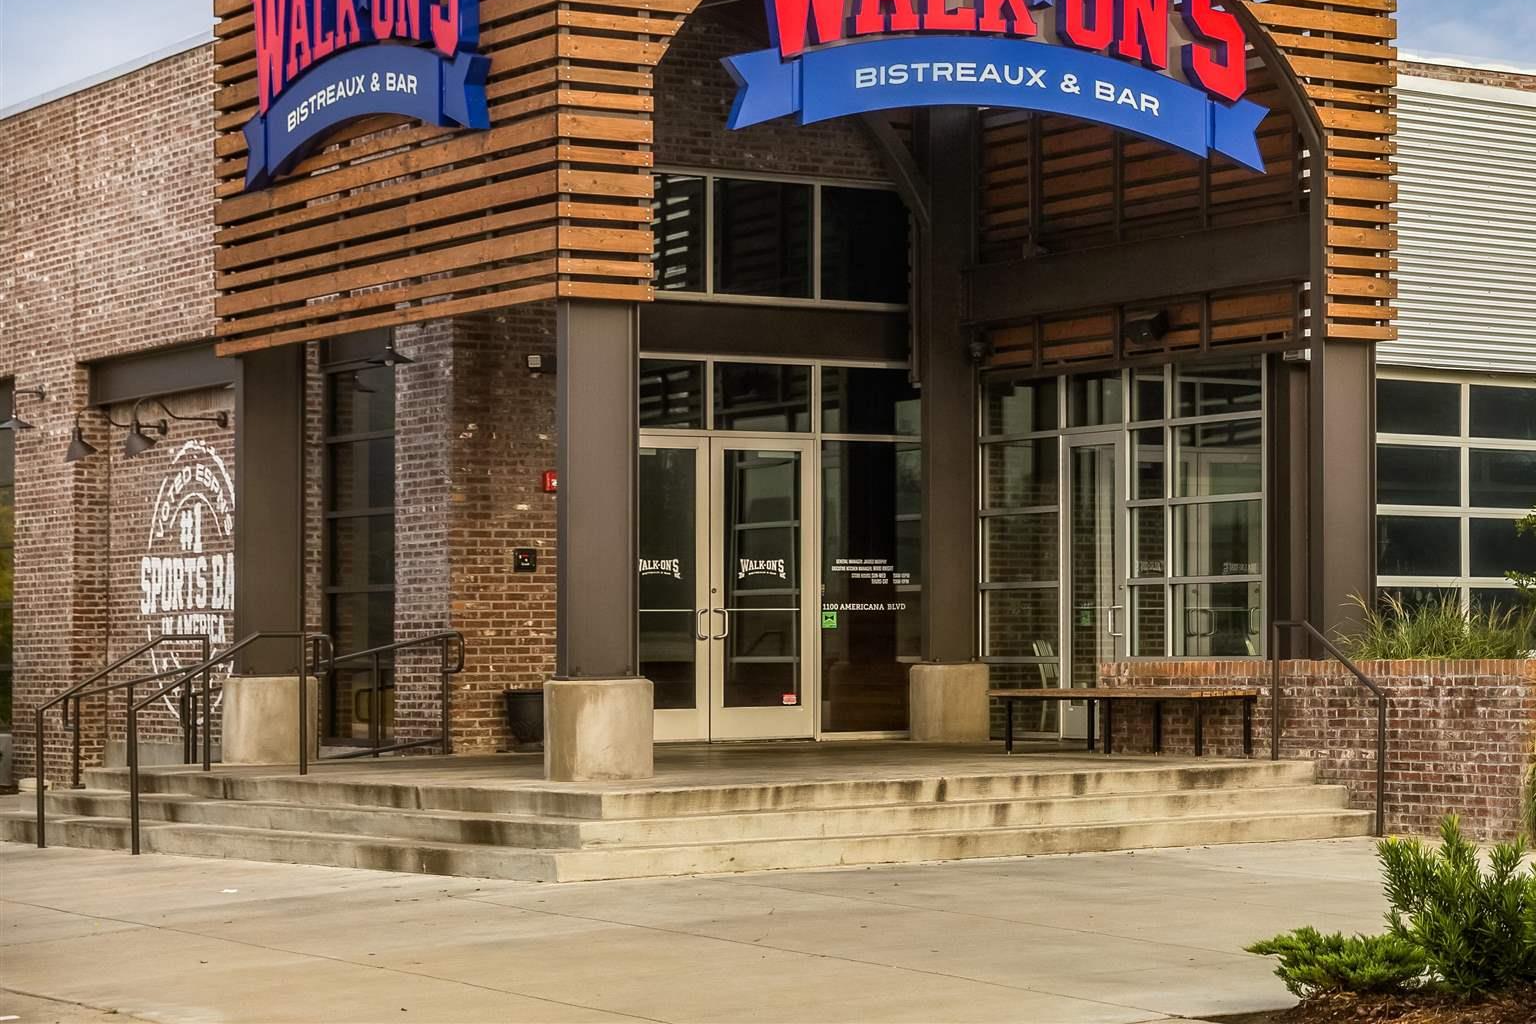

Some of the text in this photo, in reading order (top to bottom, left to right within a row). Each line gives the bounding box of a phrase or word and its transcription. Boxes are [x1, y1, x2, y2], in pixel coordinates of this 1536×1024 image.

[287, 72, 417, 133] BISTREAUX & BAR
[855, 62, 1160, 117] BISTREAUX & BAR
[156, 465, 192, 537] VOTED
[180, 502, 203, 553] #1
[140, 552, 235, 615] SPORTS BA
[822, 603, 906, 611] 1100 AMERICANA BLVD
[161, 613, 226, 645] IN AMERICA
